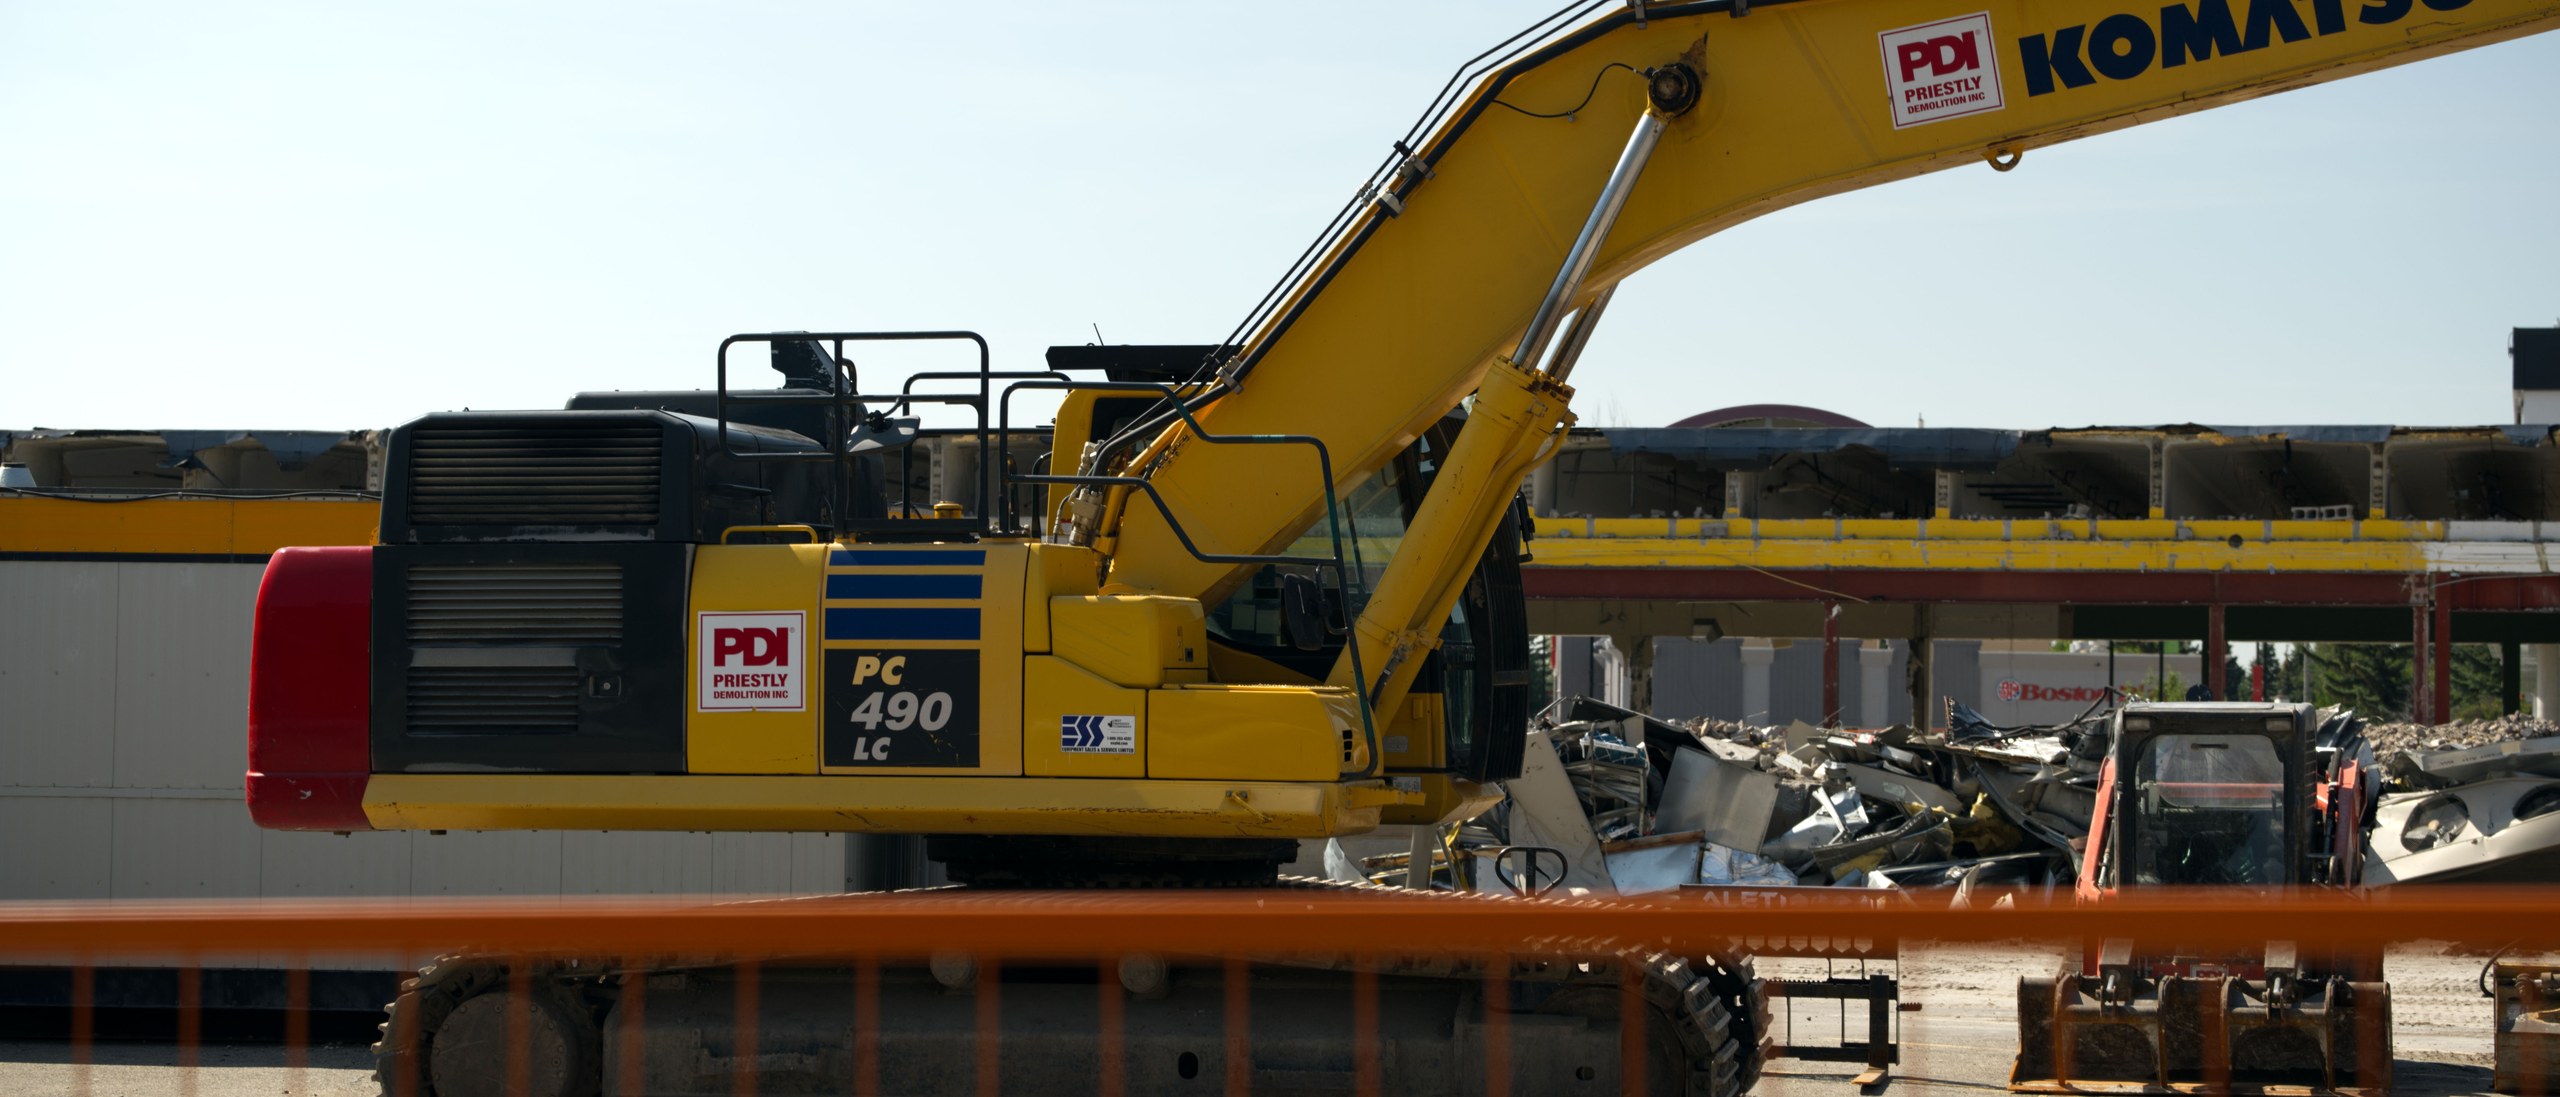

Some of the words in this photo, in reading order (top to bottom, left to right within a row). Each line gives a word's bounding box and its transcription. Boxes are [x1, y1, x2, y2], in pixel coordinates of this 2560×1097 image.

[1897, 30, 1980, 83] PDI
[1904, 75, 1981, 103] PRIESTLY
[1907, 96, 1966, 114] DEMOLITION
[1968, 92, 1985, 103] INC
[714, 627, 789, 667] PDI
[713, 674, 789, 688] PRIESTLY
[852, 655, 906, 686] PC
[713, 690, 770, 699] DEMOLITION
[772, 690, 789, 699] INC
[850, 691, 953, 732] 490
[852, 736, 891, 760] LC
